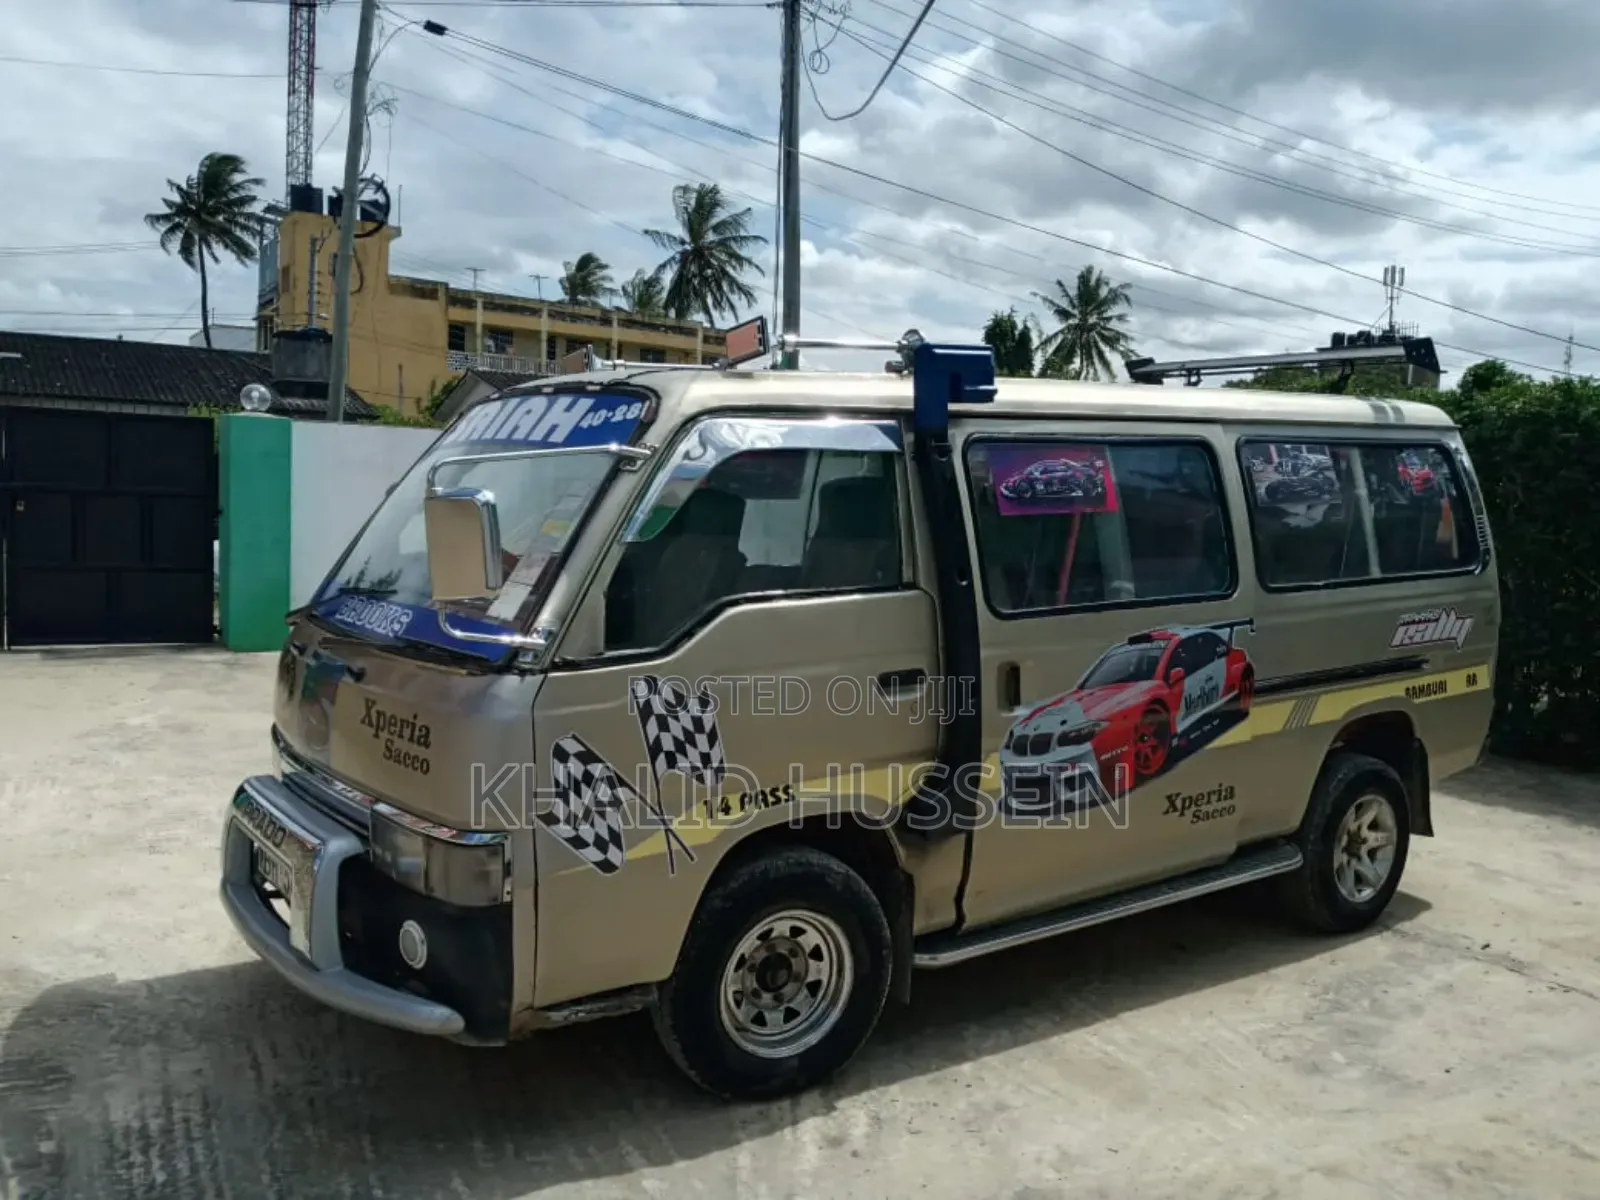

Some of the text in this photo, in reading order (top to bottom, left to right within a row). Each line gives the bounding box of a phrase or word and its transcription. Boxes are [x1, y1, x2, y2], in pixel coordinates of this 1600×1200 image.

[360, 697, 432, 749] Xperia
[382, 739, 431, 775] Sacco
[702, 783, 796, 819] 14 PASS
[1163, 782, 1236, 815] Xperia
[1189, 803, 1236, 824] Sacco
